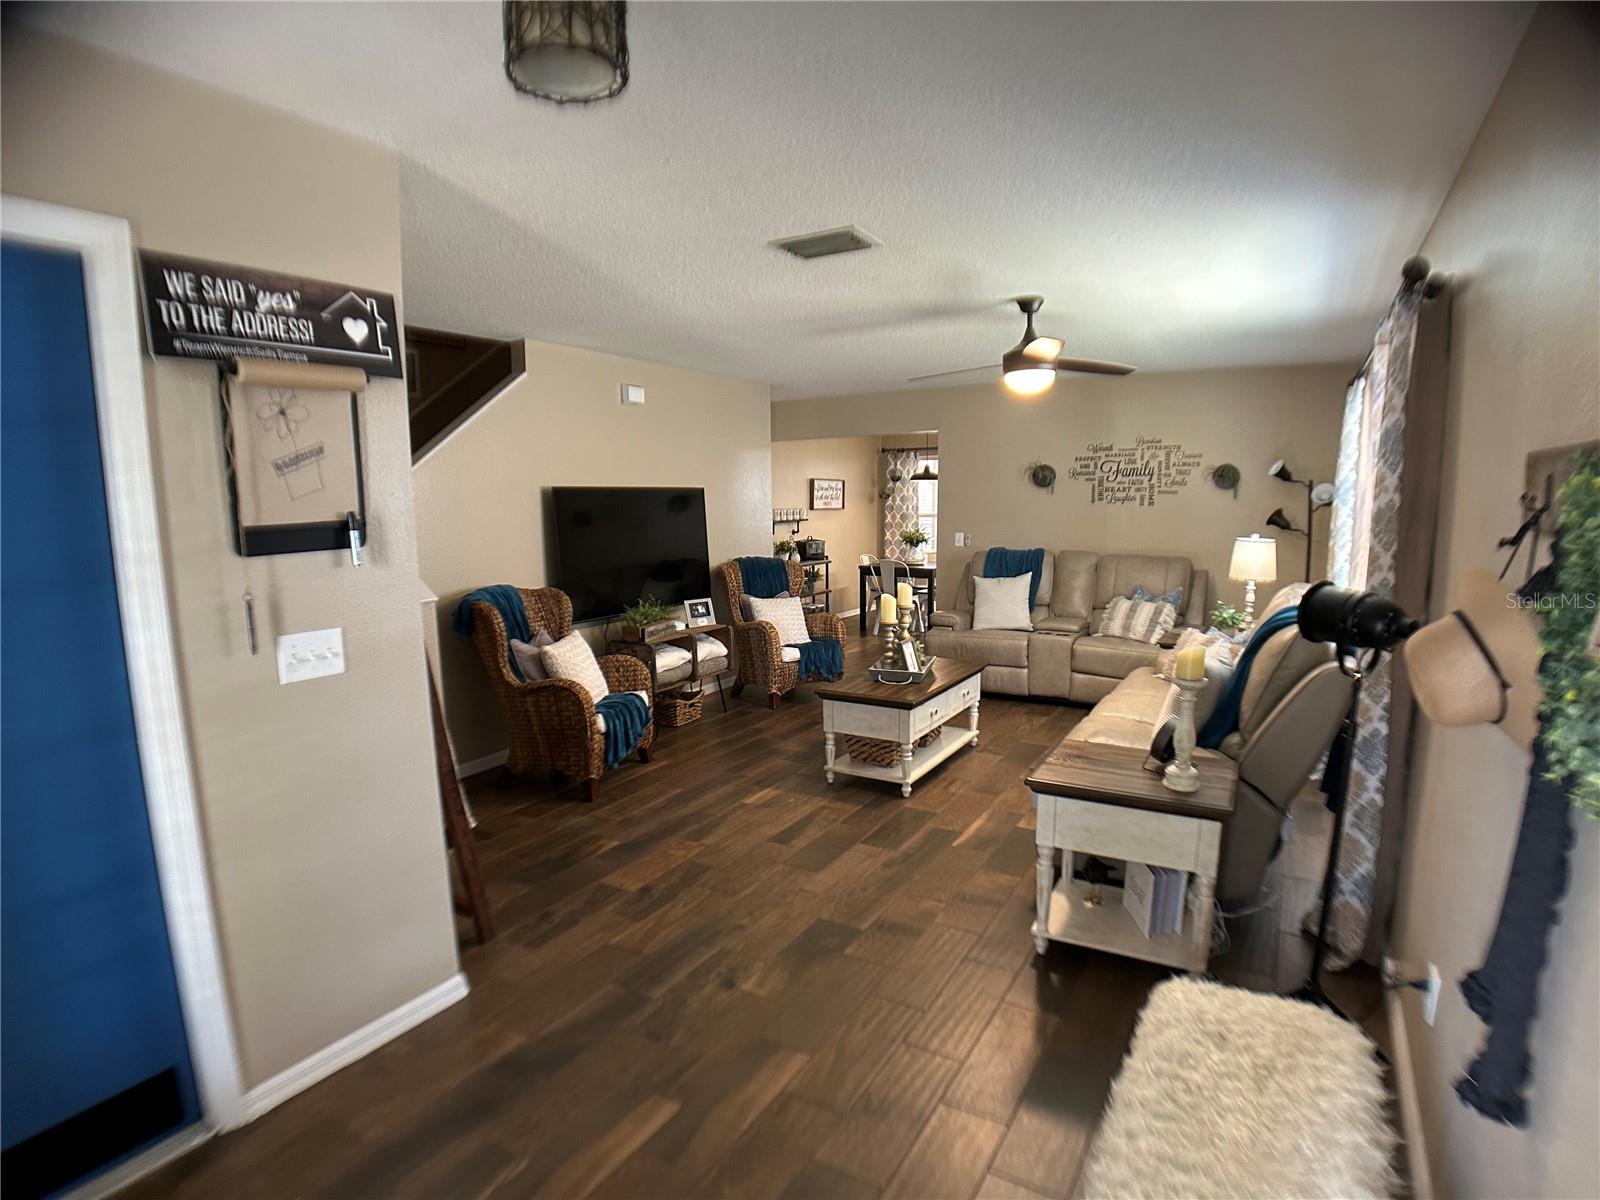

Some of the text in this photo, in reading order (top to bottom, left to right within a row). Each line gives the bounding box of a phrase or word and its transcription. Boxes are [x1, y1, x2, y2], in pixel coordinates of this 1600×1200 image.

[162, 268, 198, 300] WE
[200, 274, 246, 309] SAID
[155, 298, 316, 344] TO THE ADDRESS!
[1100, 459, 1156, 483] Family
